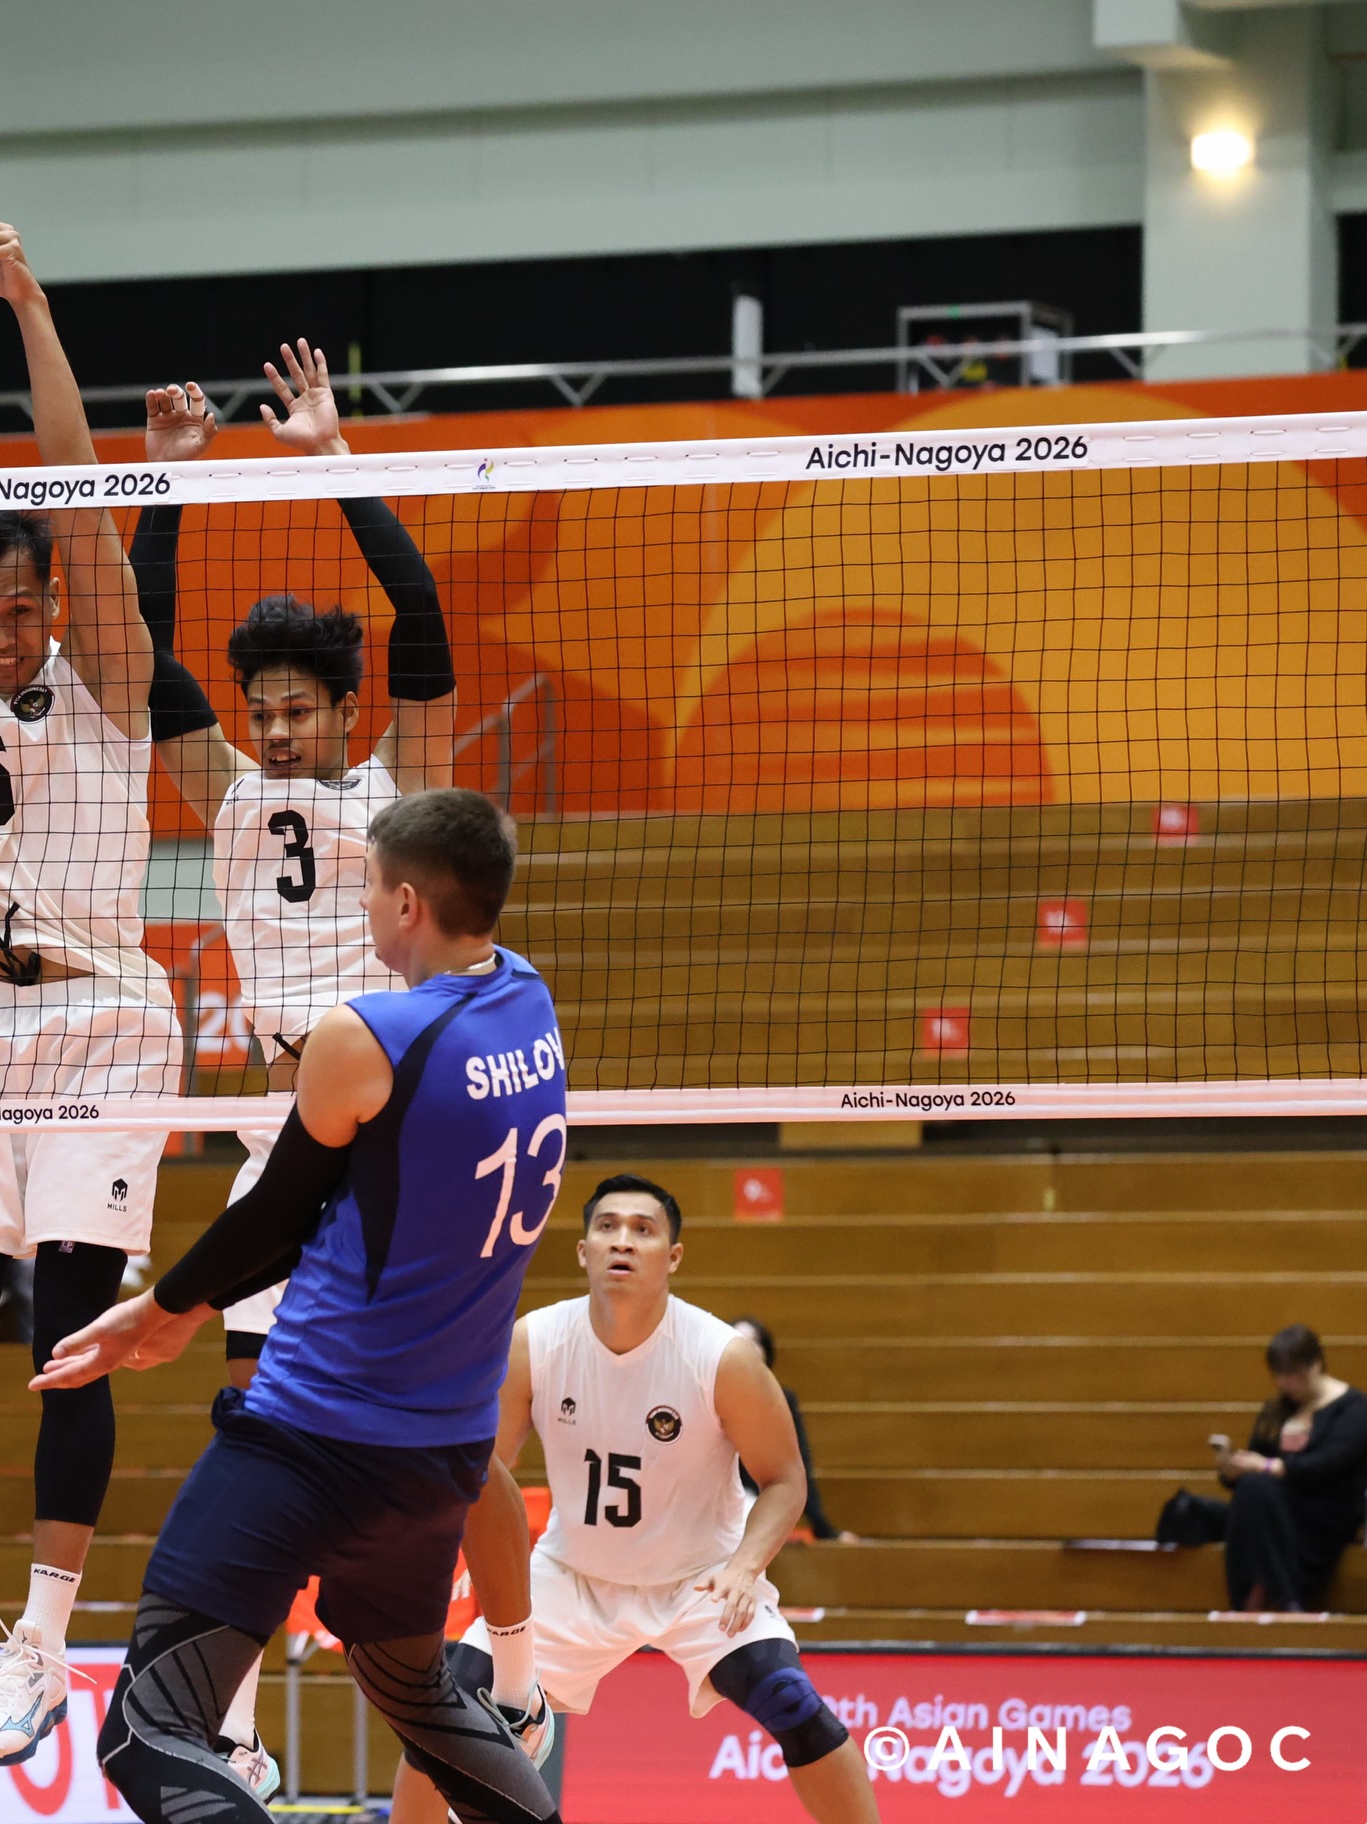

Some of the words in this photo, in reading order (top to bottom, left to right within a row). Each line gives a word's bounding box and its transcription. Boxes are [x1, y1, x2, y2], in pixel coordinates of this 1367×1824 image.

[805, 441, 1005, 471] Aichi-Nagoya
[1015, 435, 1089, 461] 2026
[103, 473, 171, 497] 2026
[267, 809, 316, 903] 3
[58, 1105, 100, 1119] 2026
[840, 1091, 965, 1112] Aichi-Nagoya
[970, 1091, 1016, 1106] 2026
[474, 1113, 567, 1258] 13
[107, 1202, 128, 1213] MILLS
[583, 1448, 642, 1528] 15
[886, 1694, 989, 1730] Asian
[997, 1697, 1132, 1733] Games
